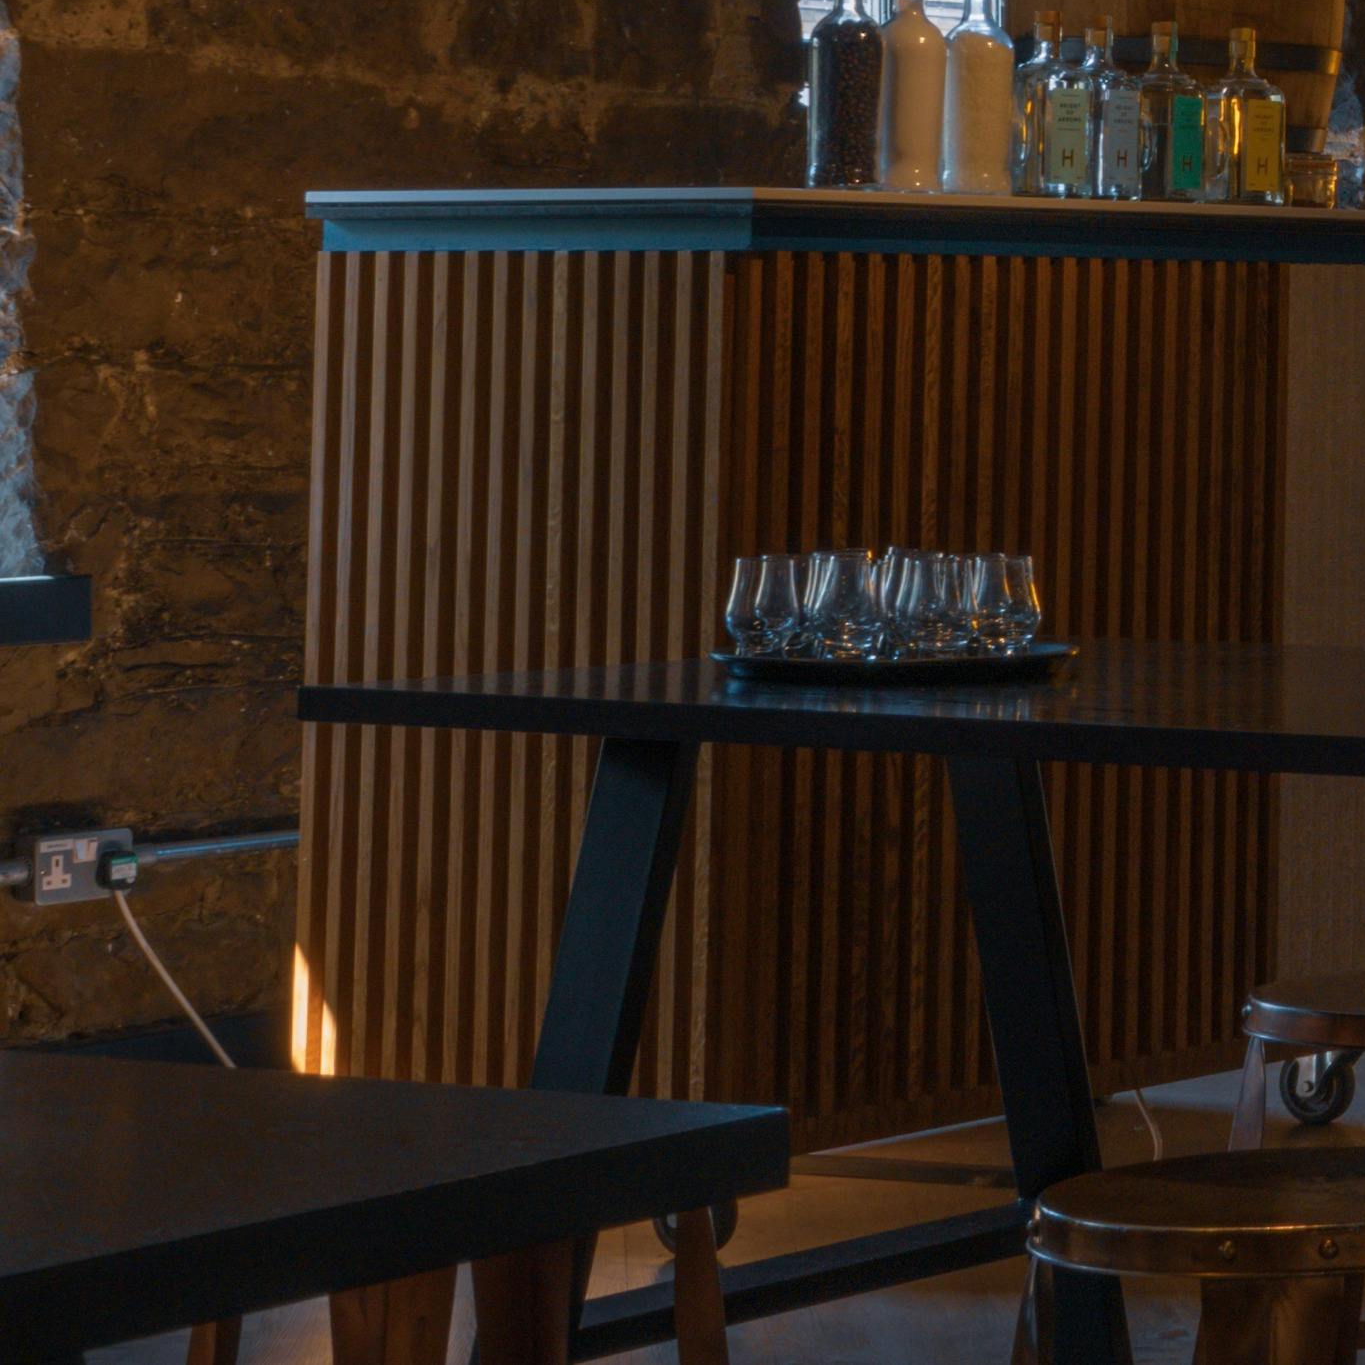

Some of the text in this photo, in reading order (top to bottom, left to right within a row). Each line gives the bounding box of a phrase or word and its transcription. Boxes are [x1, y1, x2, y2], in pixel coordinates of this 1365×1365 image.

[1062, 148, 1074, 168] H
[1116, 149, 1128, 168] H
[1182, 154, 1193, 172] H
[1257, 155, 1269, 176] H
